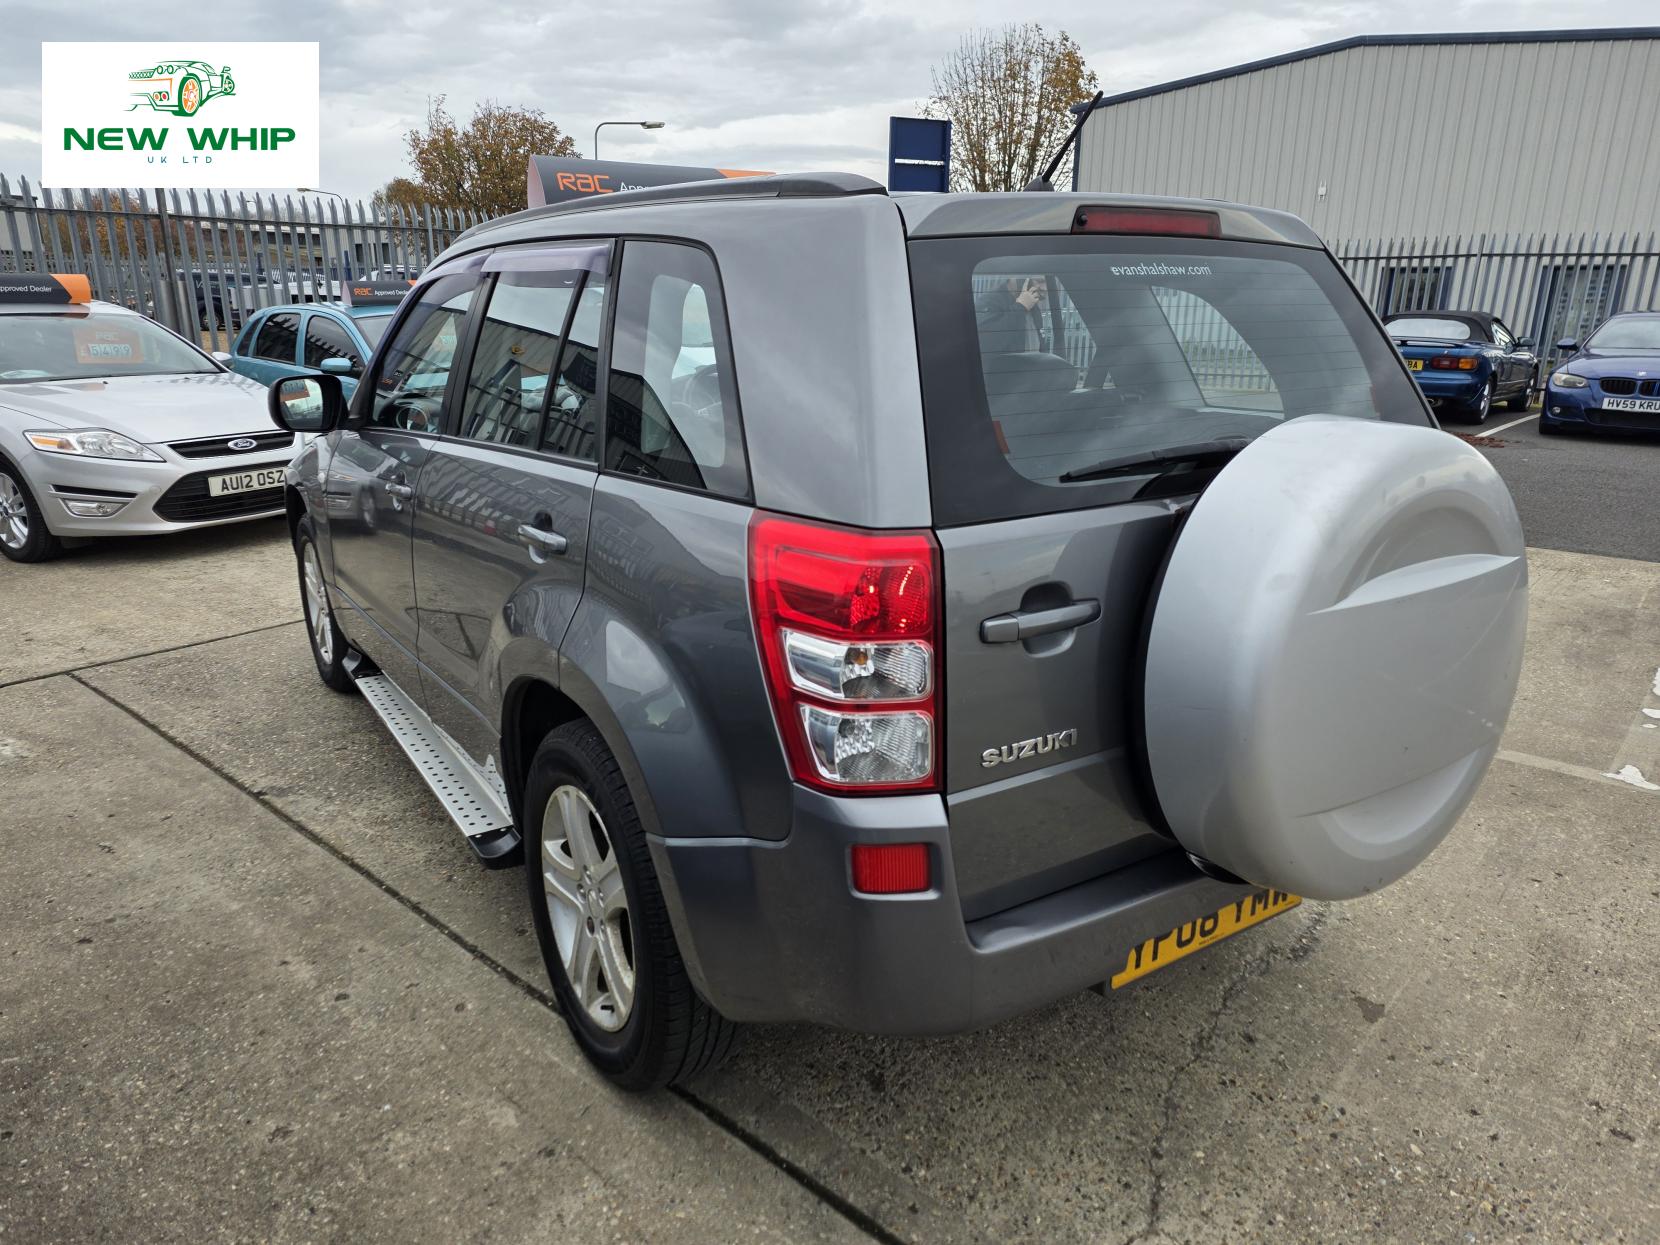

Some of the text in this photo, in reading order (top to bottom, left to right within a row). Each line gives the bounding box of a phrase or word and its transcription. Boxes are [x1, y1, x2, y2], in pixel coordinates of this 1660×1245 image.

[1110, 262, 1212, 275] evanshalshaw.com
[0, 285, 52, 293] pproved Dealer
[1607, 399, 1660, 411] HV59 KRU
[221, 469, 285, 492] AU12 OSZ
[981, 728, 1078, 768] SUZUKI
